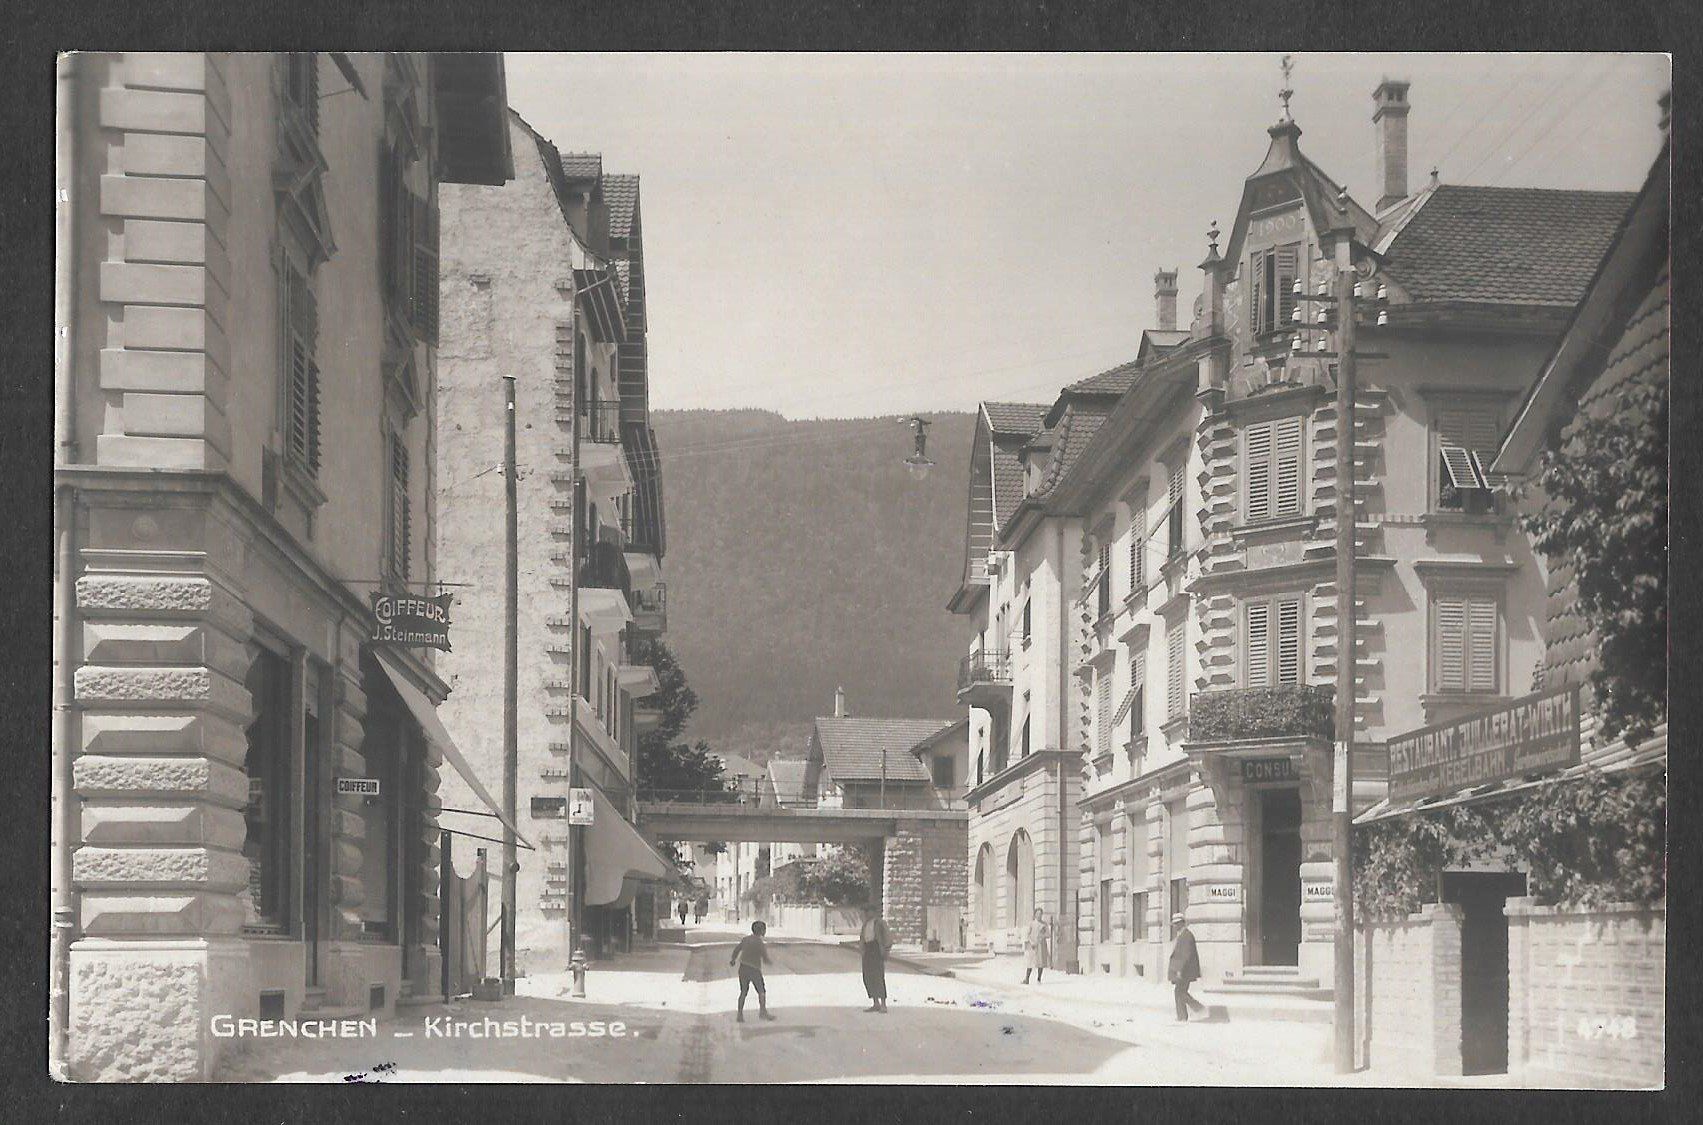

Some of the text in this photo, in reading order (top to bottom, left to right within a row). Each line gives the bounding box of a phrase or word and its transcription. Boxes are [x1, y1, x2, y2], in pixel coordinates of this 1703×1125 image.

[375, 596, 447, 625] COIFFEUR
[1246, 759, 1293, 779] CONSU
[339, 780, 378, 793] COIFFEUR
[1211, 887, 1236, 898] MAGGI
